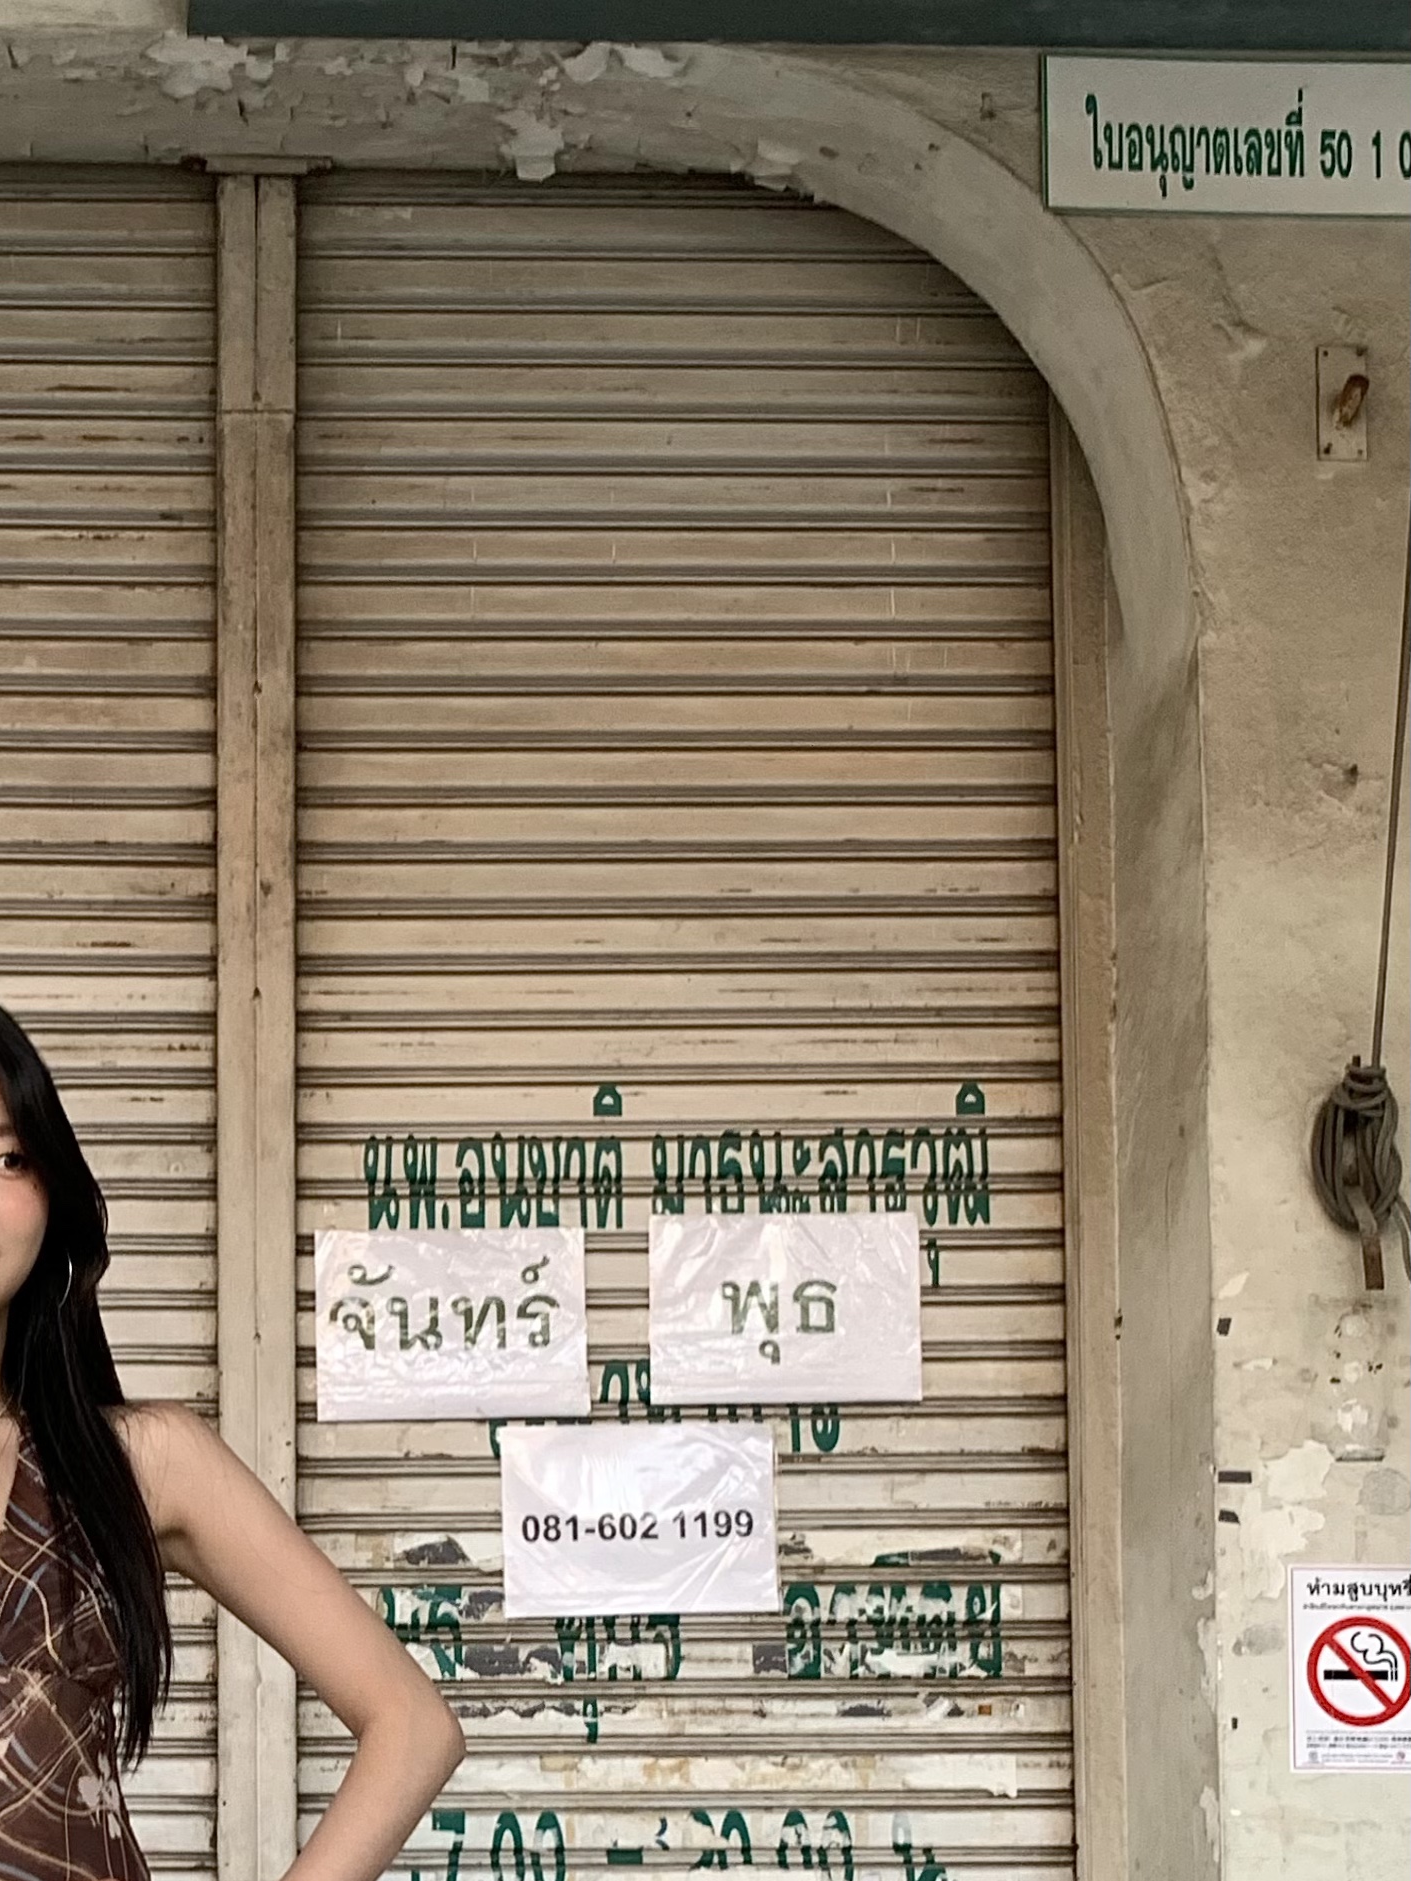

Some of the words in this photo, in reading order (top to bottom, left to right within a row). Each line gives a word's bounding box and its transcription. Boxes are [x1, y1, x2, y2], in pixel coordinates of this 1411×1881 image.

[1084, 86, 1306, 200] ใบอนุญาตเลขที่
[1319, 127, 1354, 180] 50
[1370, 128, 1383, 181] 1
[327, 1255, 562, 1351] จันทร์
[721, 1279, 839, 1365] พุธ
[520, 1512, 660, 1545] 081-602
[673, 1508, 756, 1541] 1199
[1305, 1574, 1411, 1602] ห้ามสูบบุหรี
